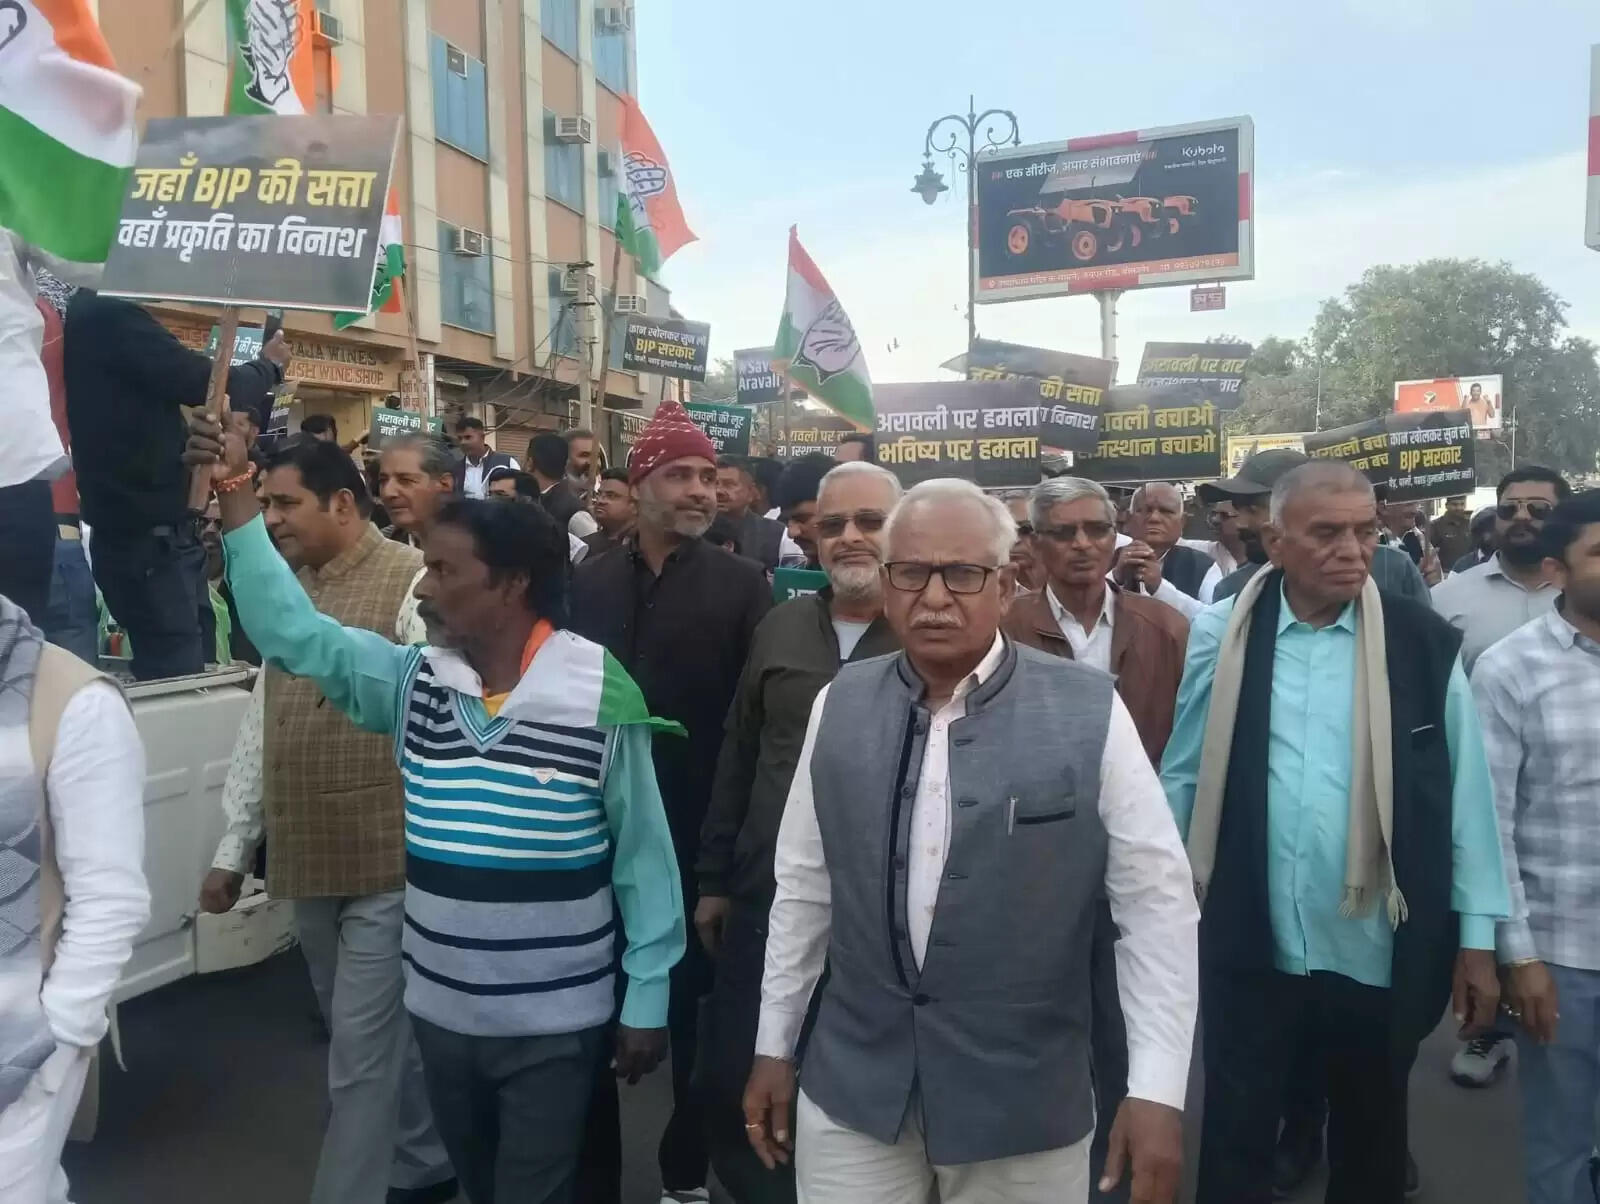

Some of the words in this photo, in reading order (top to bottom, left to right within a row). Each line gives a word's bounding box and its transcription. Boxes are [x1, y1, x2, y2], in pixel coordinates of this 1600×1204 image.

[131, 151, 195, 202] जहाँ
[193, 167, 252, 209] BJP
[257, 158, 302, 205] की
[307, 169, 378, 208] सत्ता
[118, 205, 166, 248] वहाँ
[164, 213, 236, 263] प्रकृति
[236, 223, 275, 252] का
[276, 216, 368, 258] विनाश
[326, 345, 377, 366] WINES
[636, 338, 657, 354] BJP
[658, 342, 697, 360] सरकार
[317, 364, 353, 383] WINE
[356, 368, 384, 385] SHOP
[1040, 376, 1065, 400] की
[718, 411, 729, 423] की
[877, 404, 949, 433] अरावली
[951, 408, 979, 430] पर
[981, 406, 1041, 429] हमला
[1050, 405, 1098, 432] विनाश
[1152, 400, 1217, 429] बचाओ
[1159, 429, 1217, 455] बचाओ
[1361, 433, 1389, 450] बचा
[1389, 432, 1408, 446] कान
[1409, 426, 1442, 444] खोलकर
[1443, 427, 1459, 445] सुन
[1459, 423, 1470, 439] लो
[878, 435, 942, 464] भविष्य
[944, 439, 974, 462] पर
[976, 437, 1039, 460] हमला
[1400, 450, 1420, 473] BJP
[1421, 446, 1462, 467] सरकार
